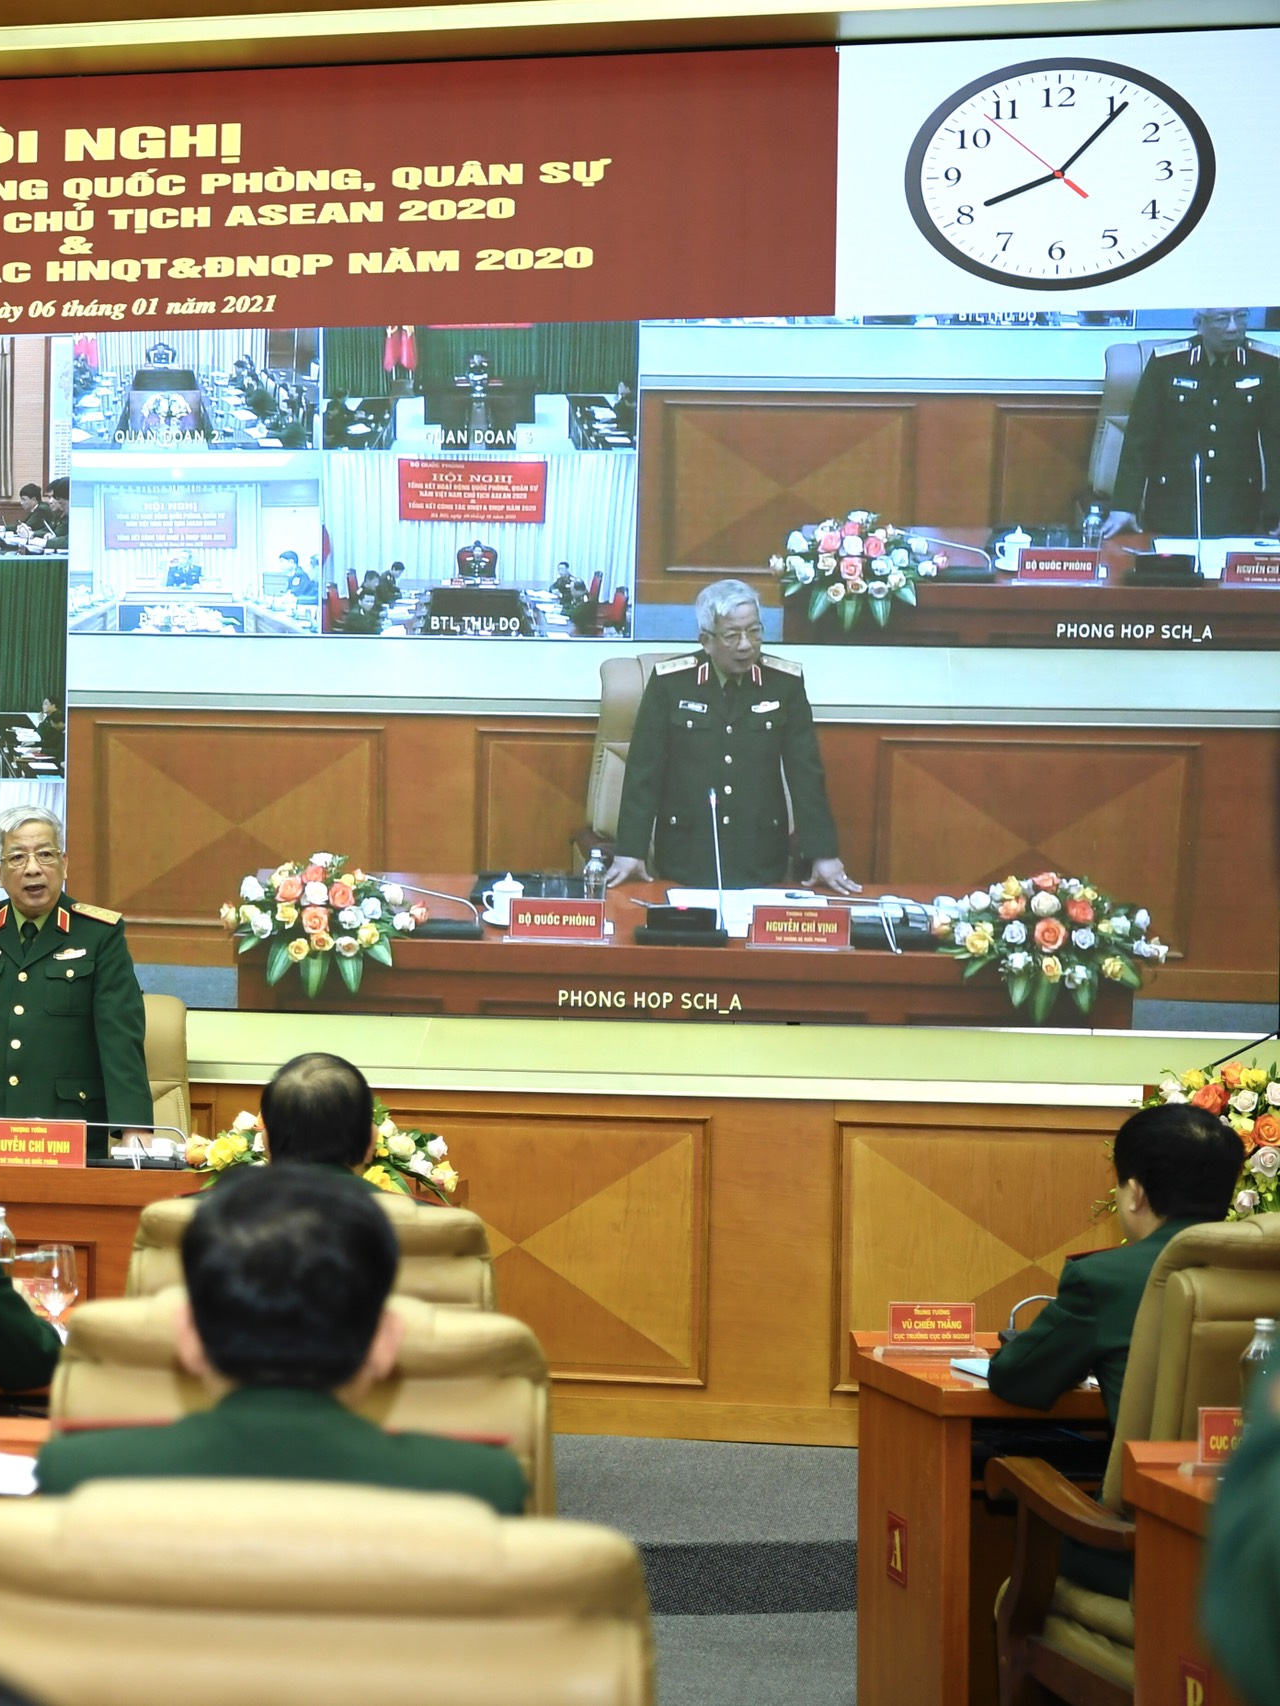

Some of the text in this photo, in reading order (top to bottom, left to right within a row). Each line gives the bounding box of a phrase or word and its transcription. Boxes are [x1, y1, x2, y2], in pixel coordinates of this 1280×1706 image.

[1043, 86, 1076, 108] 12
[991, 100, 1019, 120] 11
[958, 128, 991, 150] 10
[1142, 122, 1160, 143] 2
[65, 123, 241, 164] NGHỊ
[63, 168, 185, 201] QUỐC
[201, 166, 375, 194] PHÒNG,
[392, 161, 523, 190] QUÂN
[539, 158, 612, 187] SỰ
[944, 167, 962, 187] 9
[1156, 160, 1174, 180] 3
[3, 202, 94, 233] CHỦ
[108, 207, 211, 234] TỊCH
[225, 201, 383, 226] ASEAN
[398, 198, 515, 221] 2020
[956, 205, 974, 225] 8
[1141, 199, 1160, 220] 4
[59, 236, 93, 255] &
[996, 232, 1014, 252] 7
[1101, 228, 1118, 249] 5
[1047, 240, 1066, 261] 6
[46, 254, 333, 282] HNQT&ĐNQP
[349, 247, 459, 274] NĂM
[475, 247, 593, 270] 2020
[28, 300, 57, 318] 06
[61, 299, 127, 320] tháng
[132, 298, 159, 315] 01
[166, 298, 216, 314] năm
[221, 295, 276, 313] 2021
[115, 430, 221, 444] QUAN DOAN 2
[474, 430, 516, 444] DOAN
[431, 617, 520, 630] BTL THU DO
[1057, 623, 1213, 643] PHONG HOP SCH_A
[518, 912, 531, 927] BỘ
[534, 911, 560, 925] QUỐC
[766, 918, 837, 935] NGUYỄN CHÍ VỊNH
[558, 991, 742, 1014] PHONG HOP SCH_A
[29, 1138, 45, 1152] CHÍ
[47, 1141, 70, 1155] VỊNH
[914, 1317, 935, 1329] CHIẾN
[1210, 1435, 1228, 1454] CỤC
[890, 1530, 902, 1572] A
